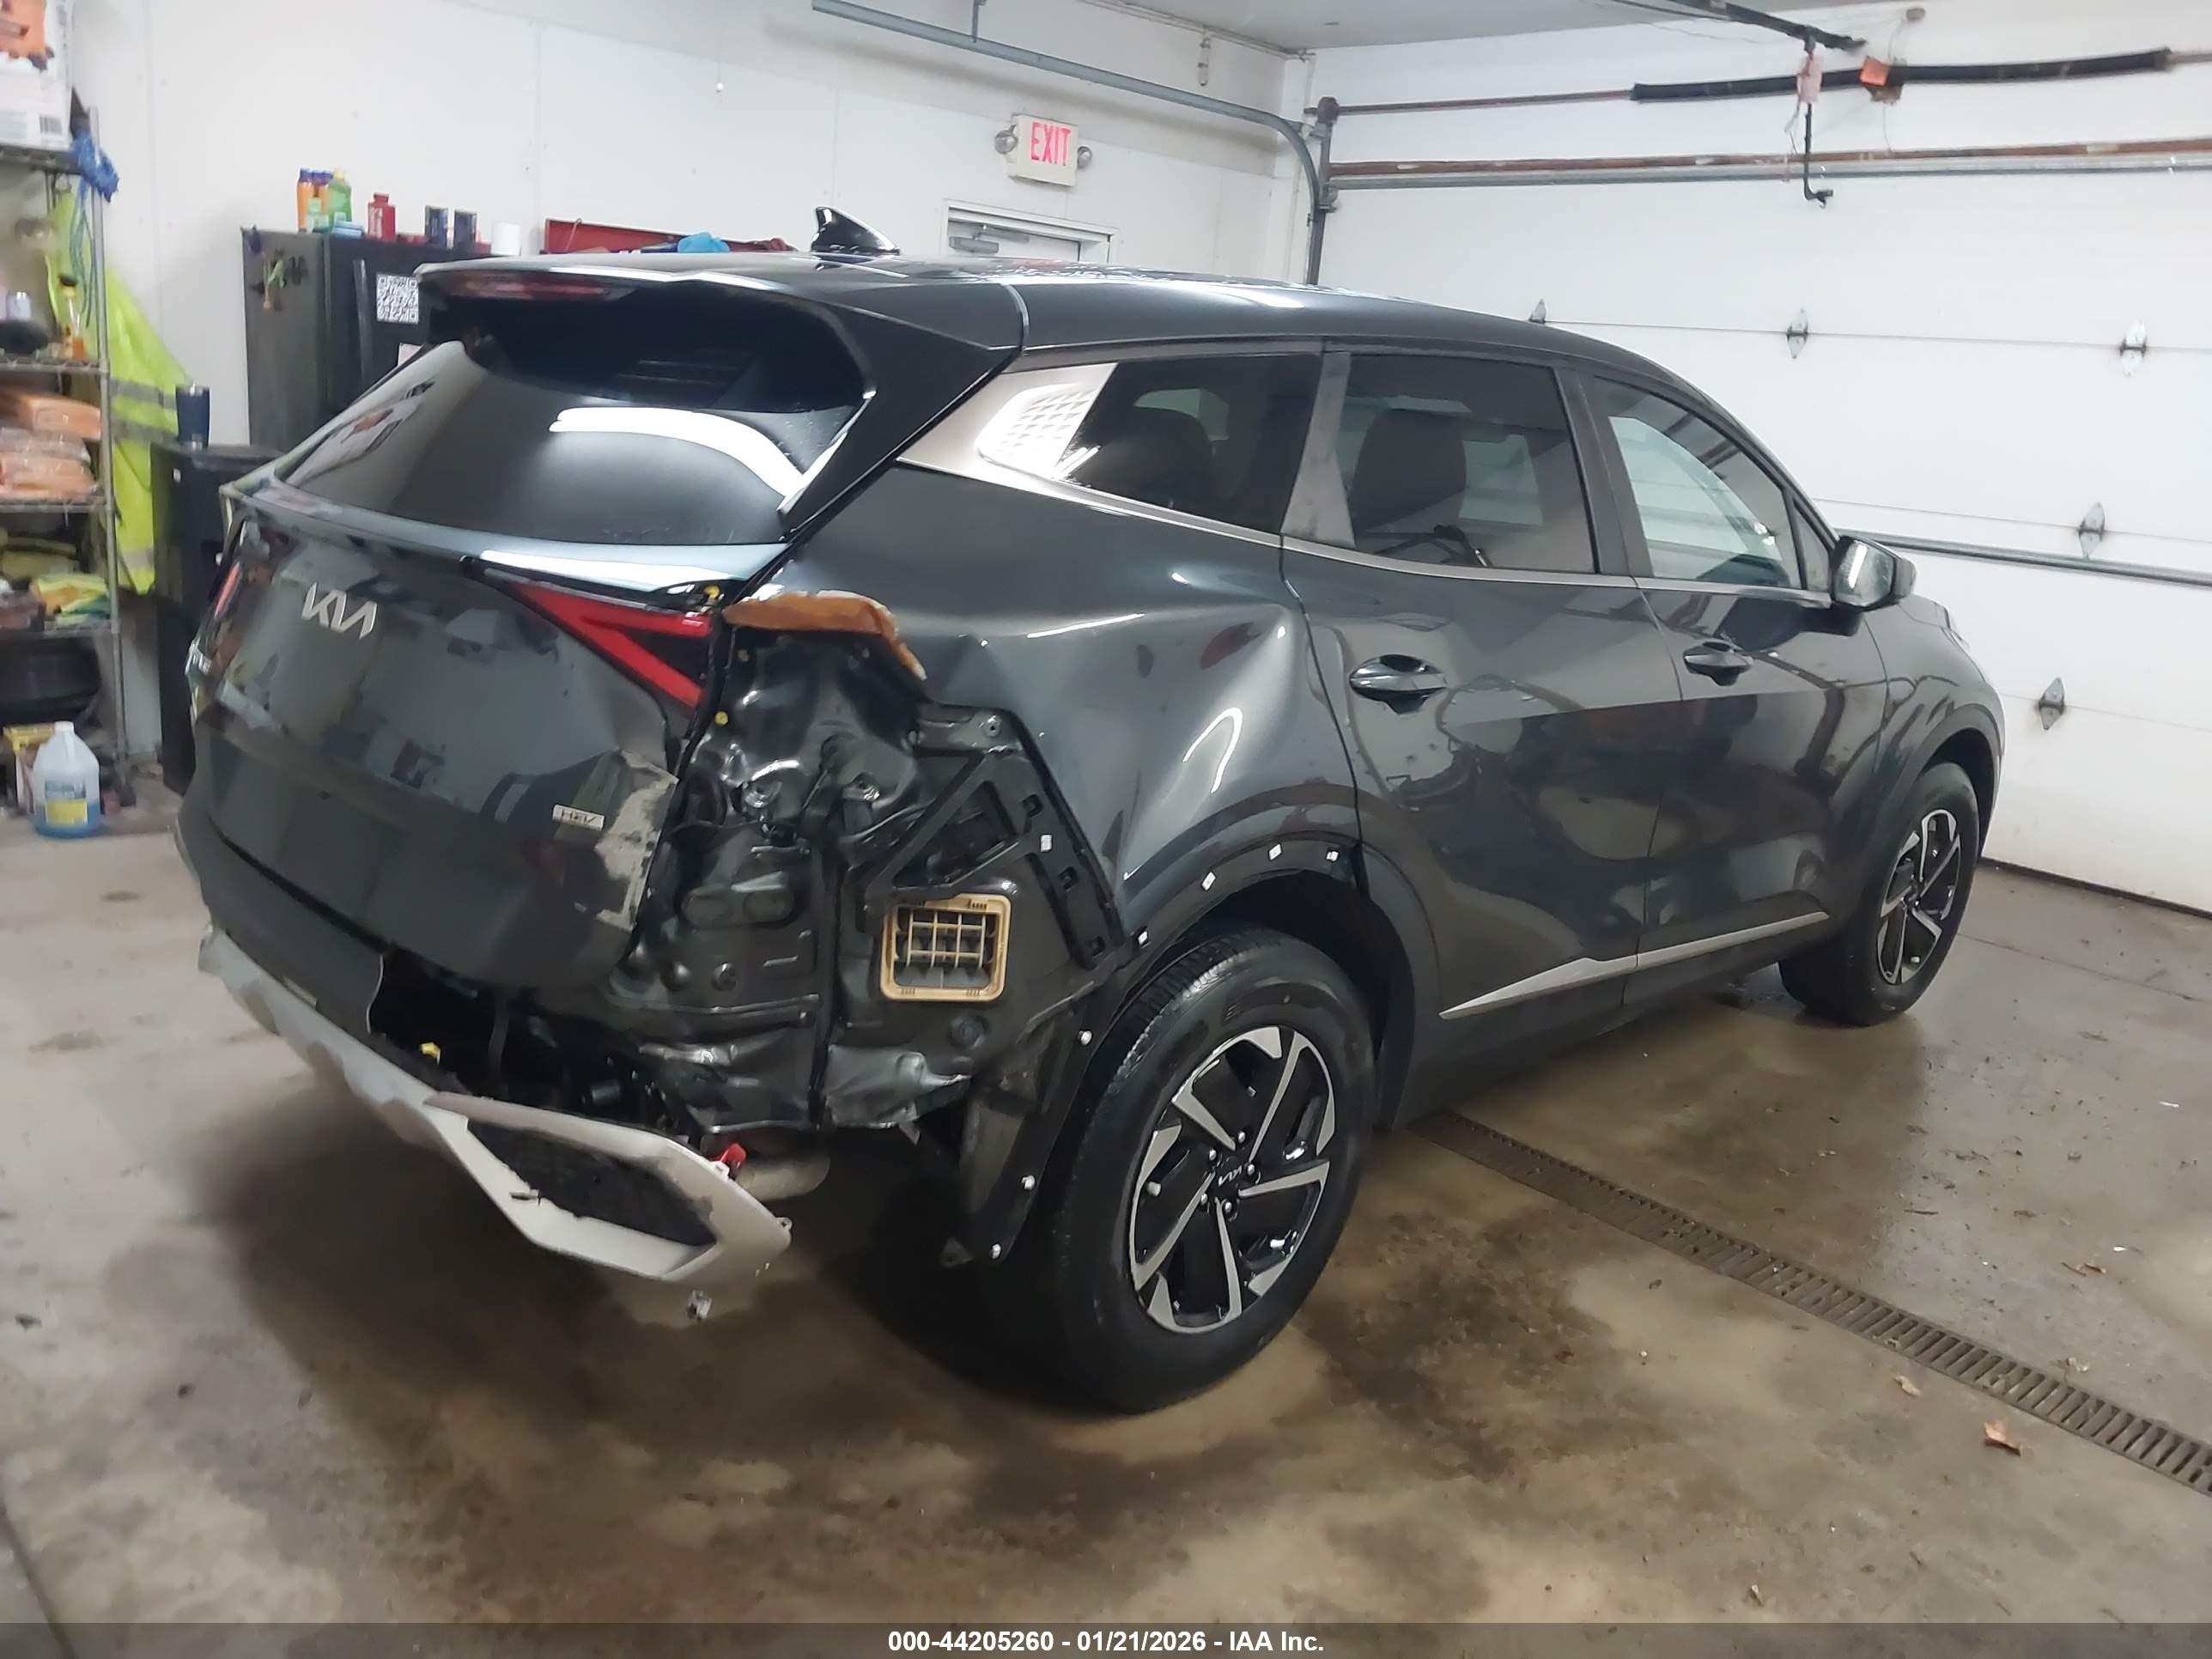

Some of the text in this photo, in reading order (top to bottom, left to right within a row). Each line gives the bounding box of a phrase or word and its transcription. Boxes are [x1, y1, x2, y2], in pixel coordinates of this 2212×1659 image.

[1030, 121, 1072, 167] EXIT
[301, 582, 378, 640] KIA
[1218, 1164, 1243, 1188] KIA
